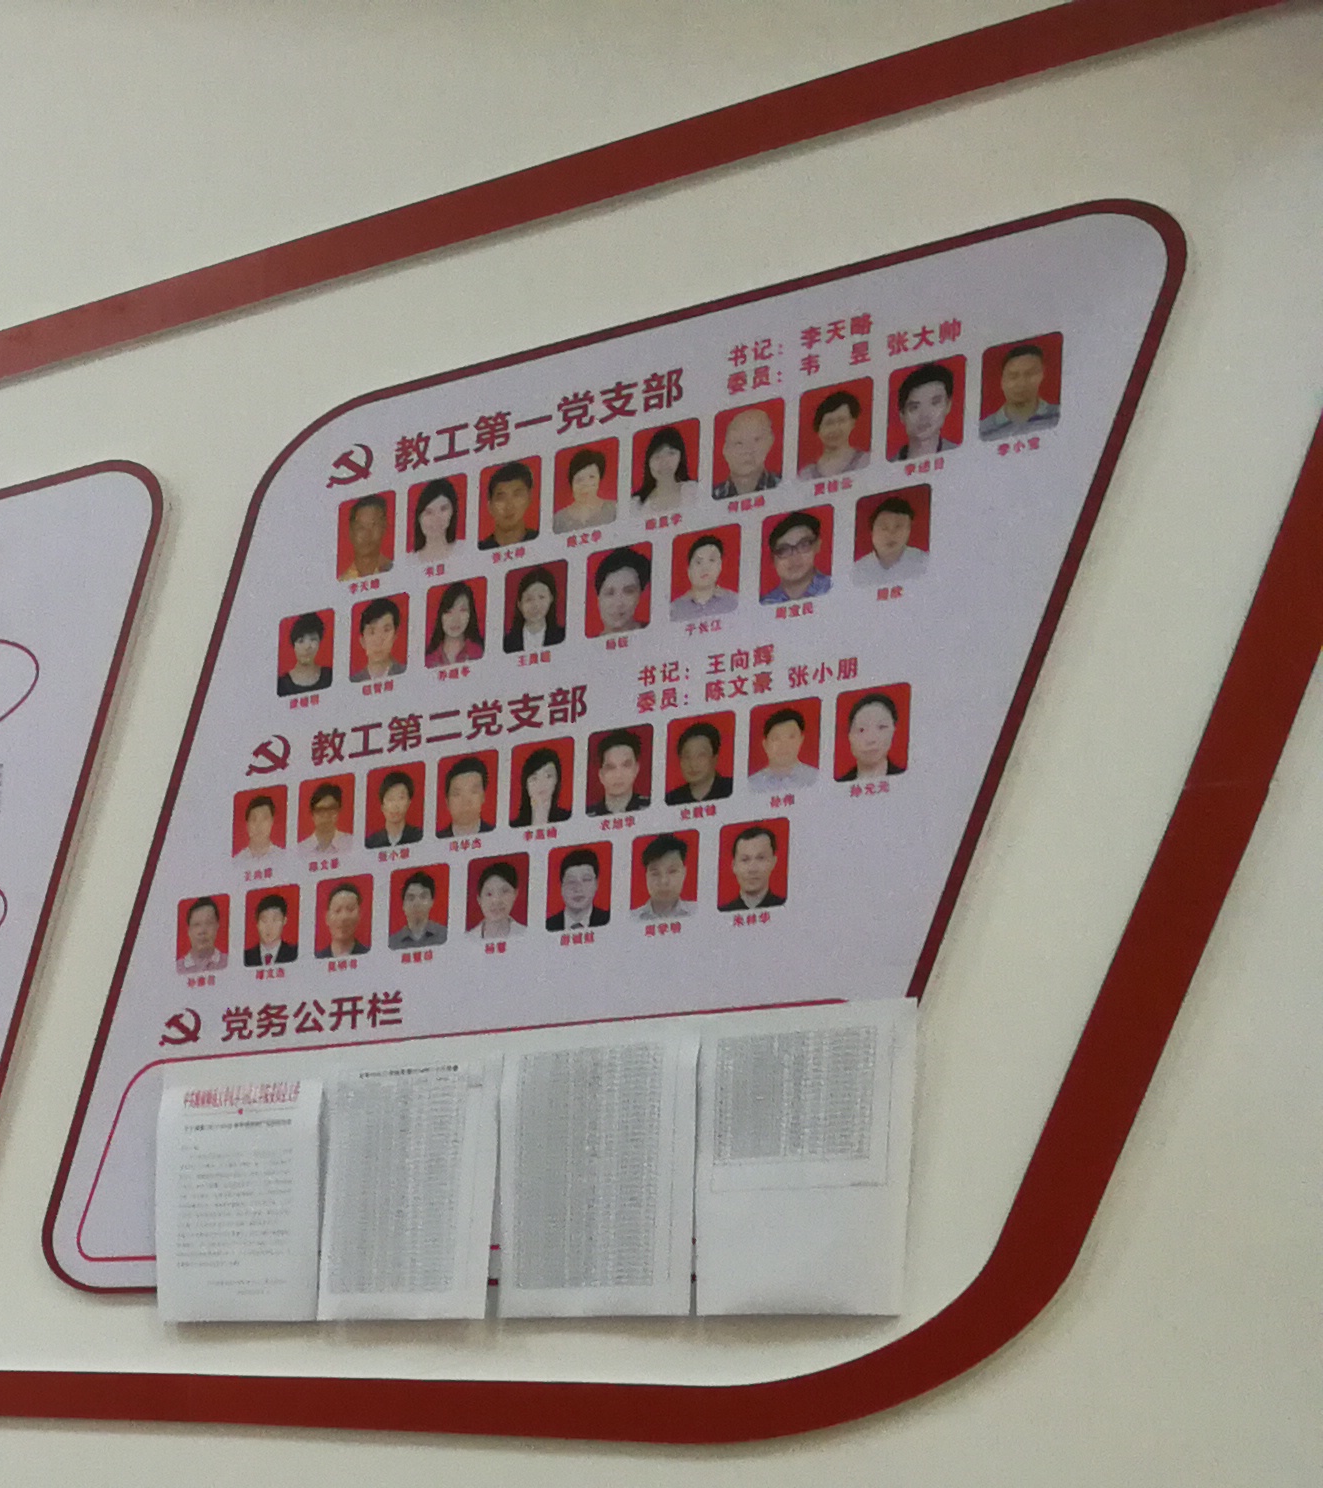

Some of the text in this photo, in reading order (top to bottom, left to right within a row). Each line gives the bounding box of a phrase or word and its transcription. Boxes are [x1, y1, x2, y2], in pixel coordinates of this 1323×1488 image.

[394, 367, 683, 473] 教工第一党支部
[788, 657, 858, 689] 张小朋
[311, 685, 588, 766] 教工第二党支部
[221, 990, 403, 1042] 党务公开栏
